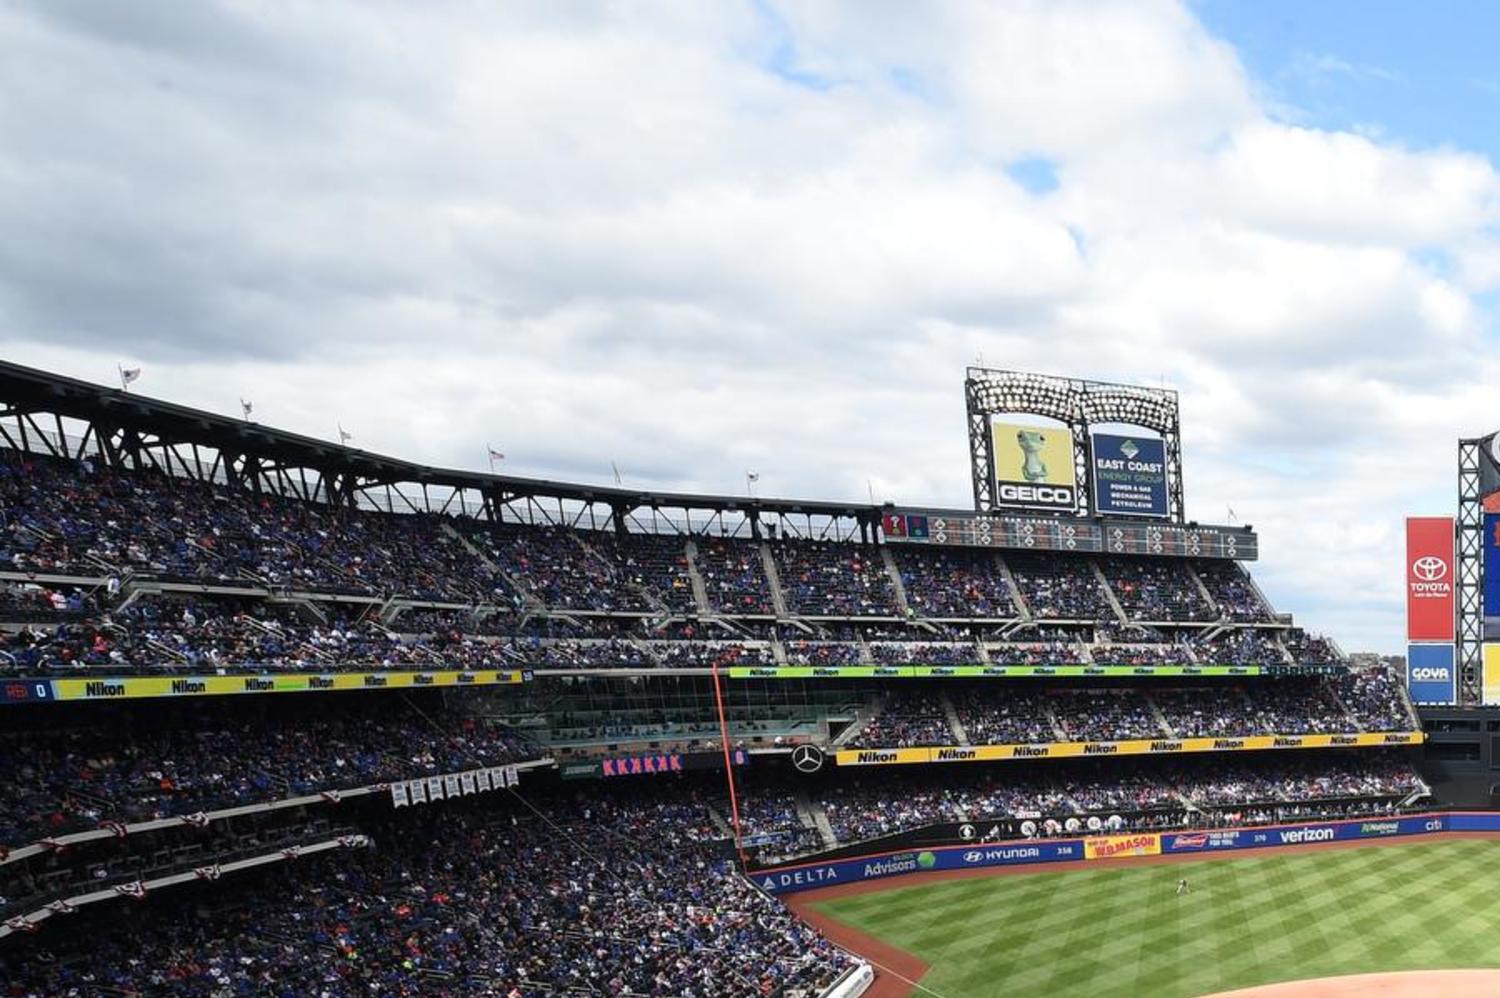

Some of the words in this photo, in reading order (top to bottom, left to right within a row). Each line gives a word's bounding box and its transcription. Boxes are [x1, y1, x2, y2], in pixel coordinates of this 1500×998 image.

[1097, 460, 1125, 470] EAST
[1128, 461, 1163, 472] COAST
[1000, 485, 1071, 503] GEICO
[1111, 500, 1152, 508] PETROLEUM
[1410, 583, 1450, 592] TOYOTA
[1412, 668, 1449, 680] GOYA
[85, 682, 125, 697] Nikon
[172, 680, 205, 693] Nikon
[245, 679, 274, 690] Nikon
[857, 752, 897, 763] Nikon
[938, 750, 976, 759] Nikon
[1013, 747, 1049, 757] Nikon
[1084, 744, 1118, 754] Nikon
[1150, 741, 1183, 751] Nikon
[1213, 739, 1244, 749] Nikon
[1273, 738, 1302, 747] Nikon
[1330, 736, 1358, 745] Nikon
[1384, 734, 1411, 743] Nikon
[1280, 827, 1334, 843] verizon
[1115, 836, 1156, 852] MASON
[986, 848, 1039, 859] HYUNDAI
[864, 859, 916, 877] Advisors
[781, 867, 837, 887] DELTA
